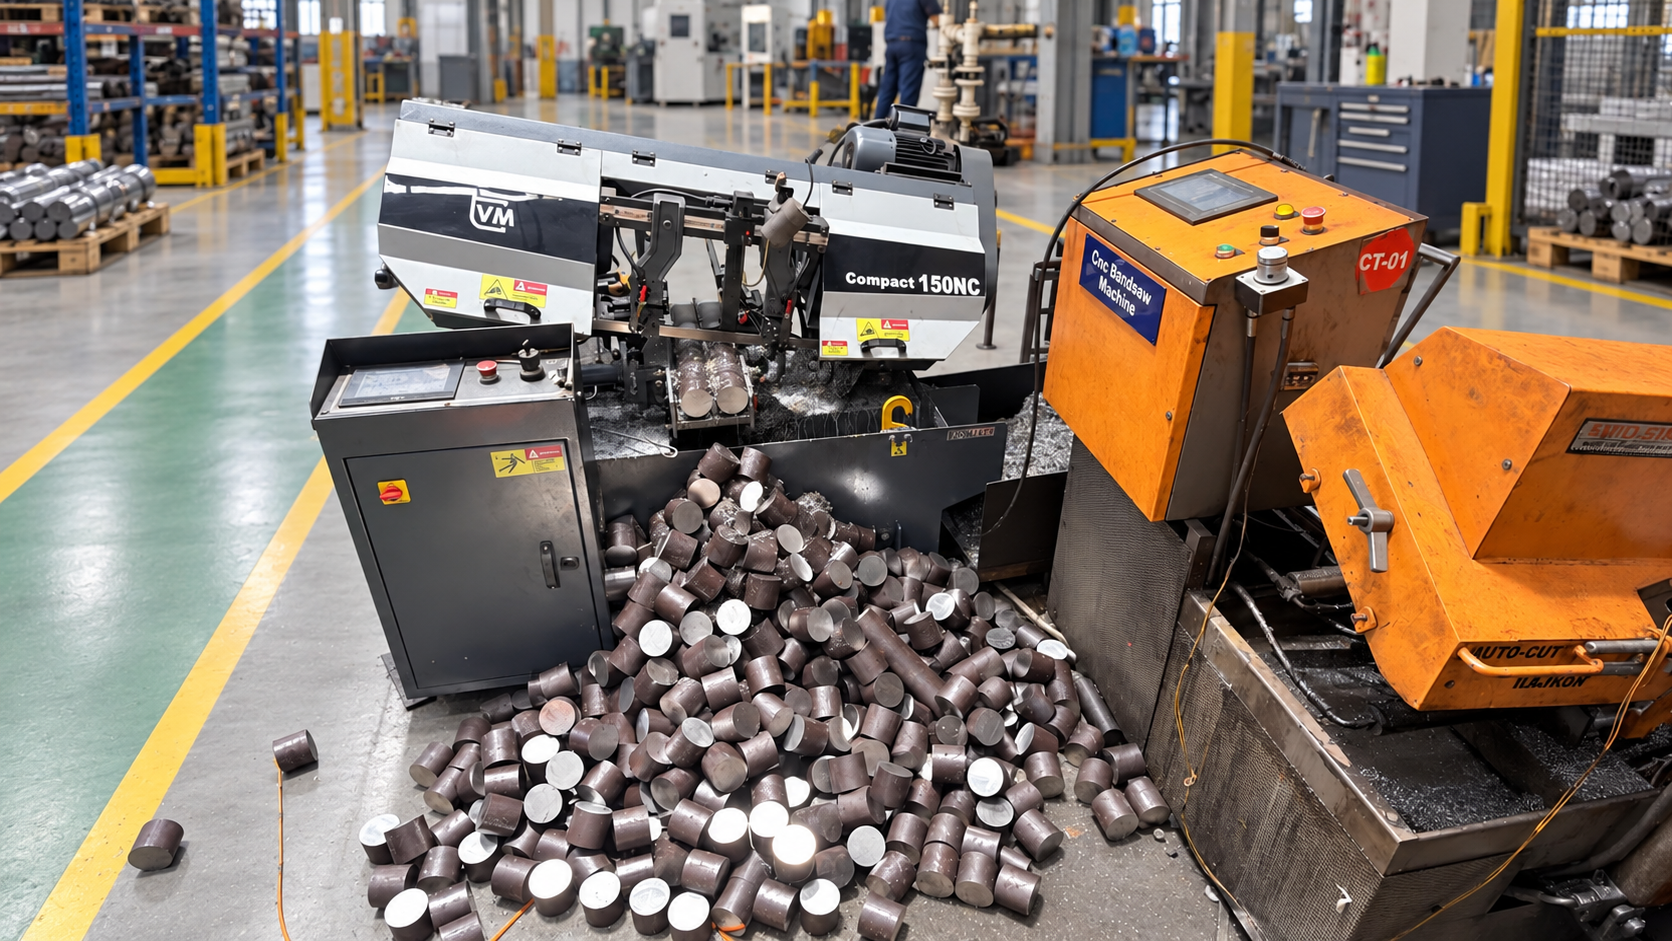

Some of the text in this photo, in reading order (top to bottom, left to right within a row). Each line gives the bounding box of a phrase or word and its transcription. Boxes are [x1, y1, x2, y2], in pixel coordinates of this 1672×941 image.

[475, 203, 515, 228] VM
[1358, 250, 1409, 272] CT-01
[845, 271, 981, 296] Compact 150NC
[1091, 249, 1152, 306] Cnc Bandsaw
[1098, 275, 1136, 317] Machine
[1472, 645, 1564, 660] AUTO-CUT
